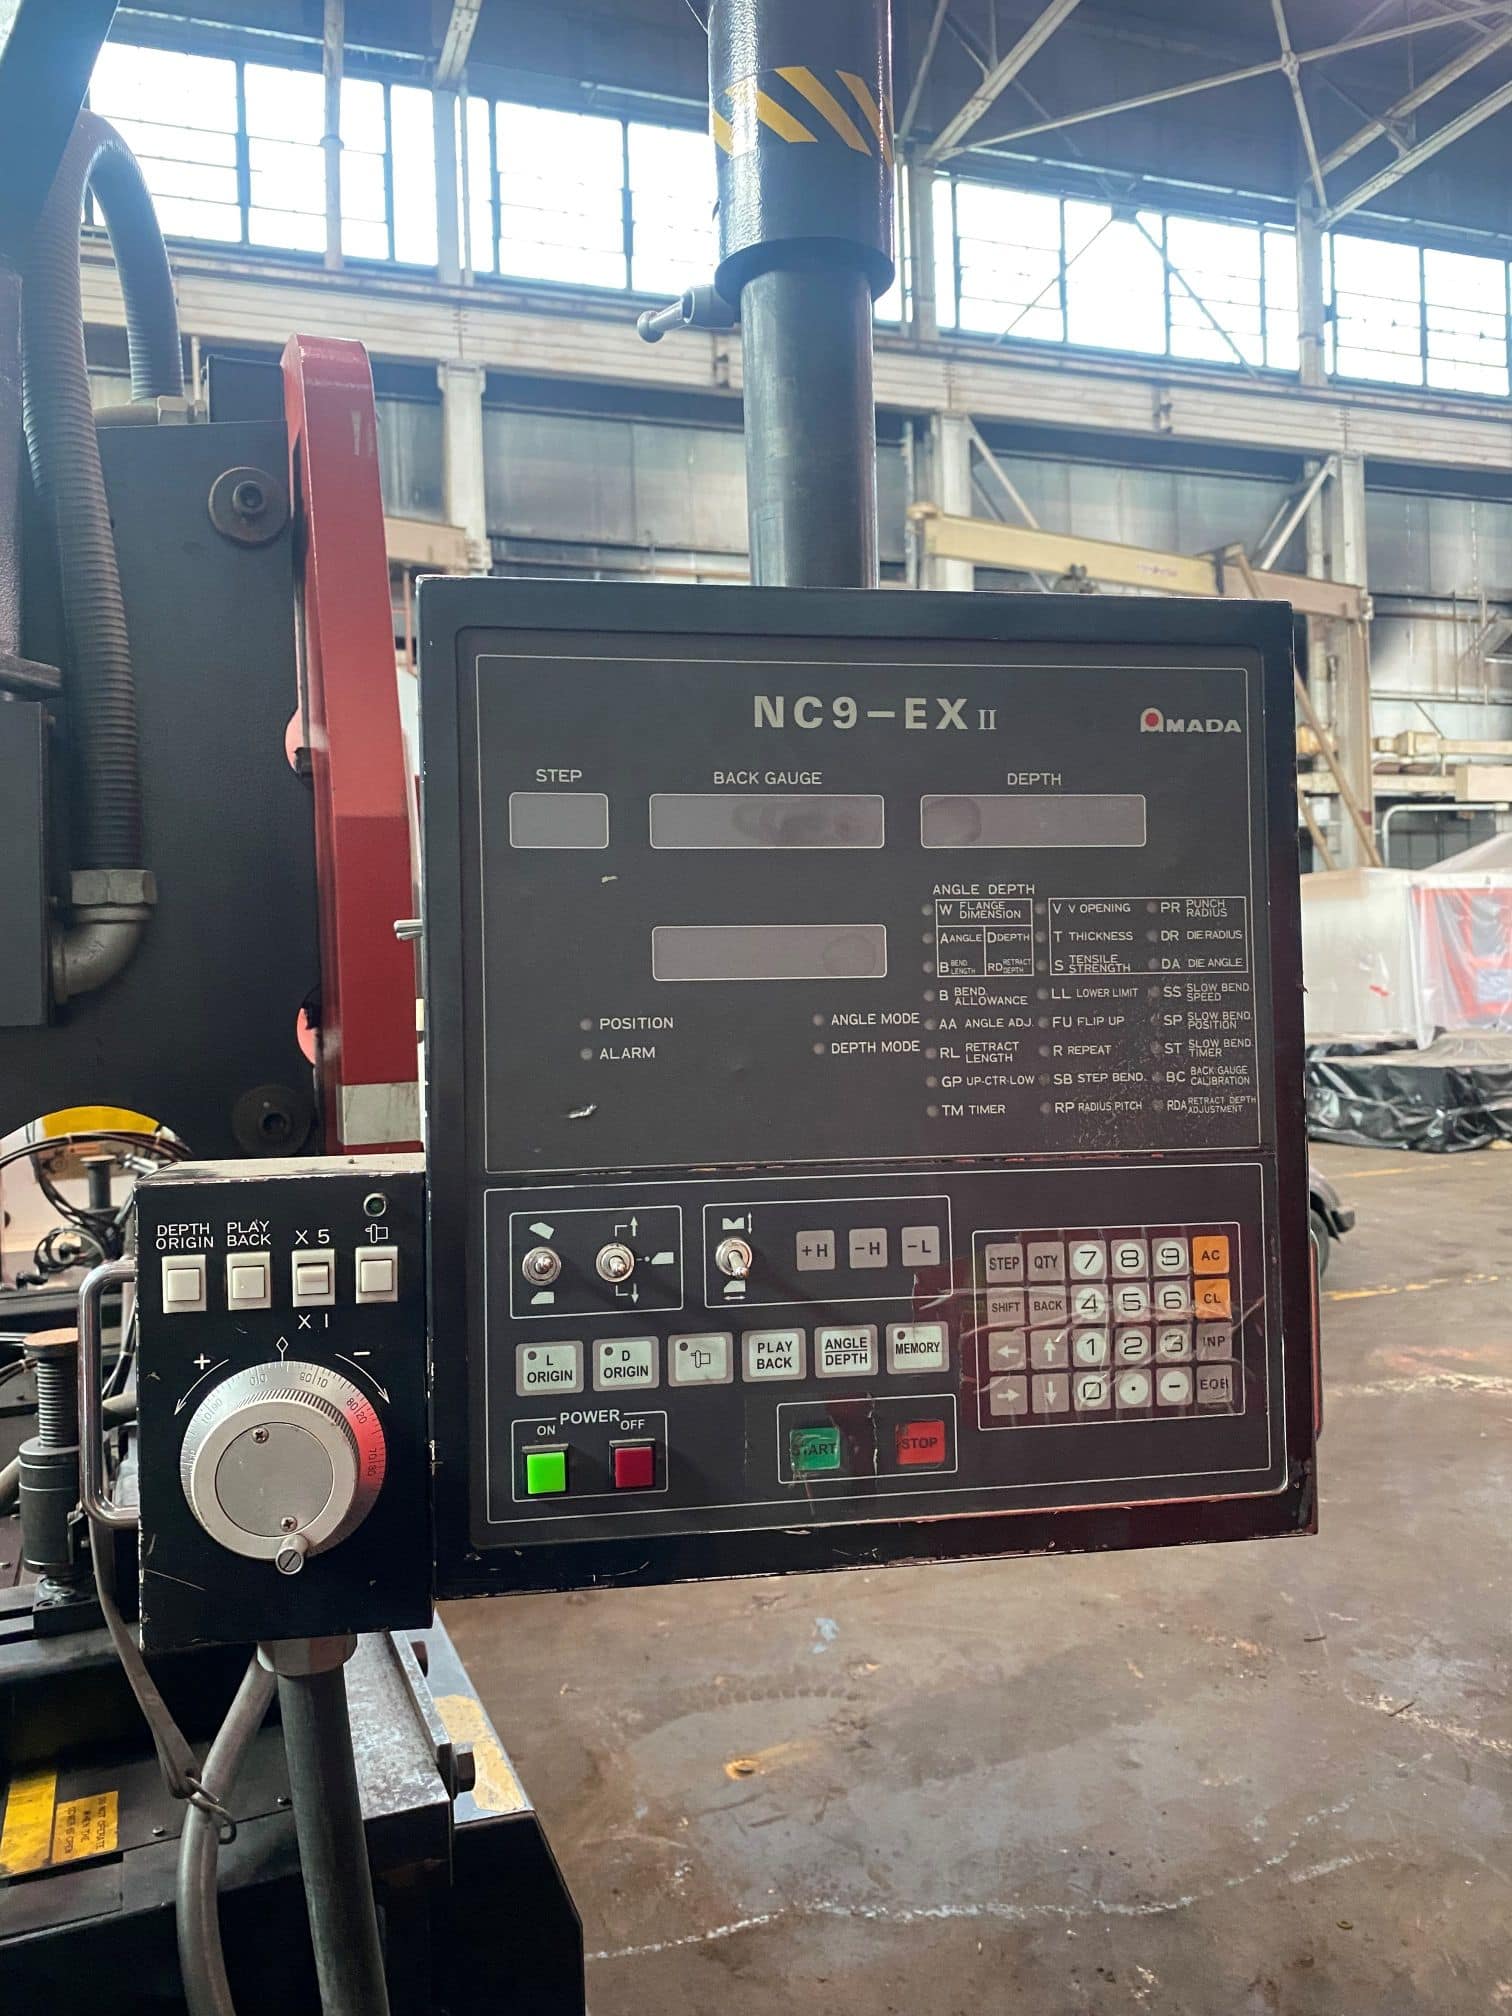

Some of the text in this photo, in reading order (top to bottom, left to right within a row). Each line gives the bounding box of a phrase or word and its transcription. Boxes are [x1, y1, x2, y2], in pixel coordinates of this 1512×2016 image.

[1140, 707, 1242, 733] AMADA
[535, 769, 582, 784] STEP
[713, 772, 822, 785] BACK GAUGE
[1007, 773, 1062, 786] DEPTH
[932, 884, 1035, 896] ANGLE DEPTH
[939, 901, 1006, 916] W FLANGE
[1052, 903, 1062, 914] V
[1079, 903, 1132, 914] OPENING
[1160, 899, 1226, 913] PR PUNCH
[959, 910, 1022, 919] DIMENSION
[1186, 908, 1228, 918] RADIUS
[940, 932, 982, 944] A ANGLE
[987, 931, 1030, 943] D DEPTH
[1053, 931, 1134, 942] T THICKNESS
[1160, 930, 1243, 942] DR DIE RADIUS
[1069, 954, 1119, 964] TENSILE
[1161, 957, 1243, 970] DA DIE ANGLE
[940, 961, 950, 973] B
[987, 962, 1003, 972] RD
[1054, 959, 1131, 973] S STRENGTH
[939, 986, 986, 1001] B BEND
[1051, 987, 1139, 1000] LL LOWER LIMIT
[1163, 983, 1250, 998] SS SLOW BEND
[1186, 992, 1222, 1002] SPEED
[954, 995, 1029, 1006] ALLOWANCE
[599, 1017, 674, 1030] POSITION
[831, 1012, 920, 1025] ANGLE MODE
[938, 1018, 957, 1030] AA
[964, 1018, 1004, 1028] ANGLE
[1052, 1016, 1125, 1028] FU FLIP UP
[1163, 1011, 1251, 1026] SP SLOW BEND
[1188, 1020, 1237, 1030] POSITION
[831, 1040, 920, 1054] DEPTH MODE
[965, 1041, 1020, 1052] RETRACT
[1053, 1045, 1112, 1056] R REPEAT
[1164, 1042, 1183, 1054] ST
[1188, 1039, 1219, 1049] SLOW
[1188, 1048, 1222, 1058] TIMER
[599, 1047, 656, 1060] ALARM
[940, 1047, 1013, 1064] RL LENGTH
[1053, 1073, 1072, 1085] SB
[1077, 1073, 1108, 1083] STEP
[1166, 1065, 1248, 1083] BC BACK GAUGE
[941, 1076, 963, 1088] GP
[1190, 1076, 1250, 1086] CALIBRATION
[1055, 1101, 1143, 1113] RP RADIUS PITCH
[1167, 1099, 1188, 1111] RDA
[1187, 1096, 1225, 1105] RETRACT
[1187, 1105, 1243, 1114] ADJUSTMENT
[941, 1104, 1006, 1117] TM TIMER
[157, 1223, 210, 1236] DEPTH
[227, 1220, 270, 1233] PLAY
[155, 1236, 214, 1249] ORIGIN
[227, 1234, 271, 1247] BACK
[295, 1229, 330, 1245] X 5
[1034, 1255, 1058, 1269] QTY
[1079, 1251, 1097, 1270] 7
[1120, 1249, 1140, 1268] 8
[1161, 1248, 1180, 1266] 9
[1201, 1250, 1220, 1261] AC
[989, 1256, 1020, 1271] STEP
[1080, 1294, 1099, 1312] 4
[1122, 1293, 1141, 1311] 5
[1163, 1291, 1183, 1310] 6
[1203, 1293, 1221, 1304] CL
[991, 1302, 1021, 1313] SHIFT
[1033, 1300, 1063, 1311] BACK
[297, 1314, 311, 1329] X
[757, 1340, 793, 1354] PLAY
[824, 1337, 868, 1350] ANGLE
[895, 1341, 940, 1355] MEMORY
[1086, 1338, 1095, 1356] 1
[1123, 1336, 1142, 1355] 2
[1164, 1335, 1183, 1353] 3
[546, 1354, 554, 1366] L
[621, 1350, 631, 1362] D
[825, 1353, 868, 1366] DEPTH
[756, 1357, 792, 1370] BACK
[527, 1370, 573, 1383] ORIGIN
[603, 1365, 649, 1379] ORIGIN
[559, 1409, 620, 1426] POWER
[537, 1425, 556, 1436] ON
[620, 1418, 645, 1431] OFF
[901, 1437, 938, 1450] STOP
